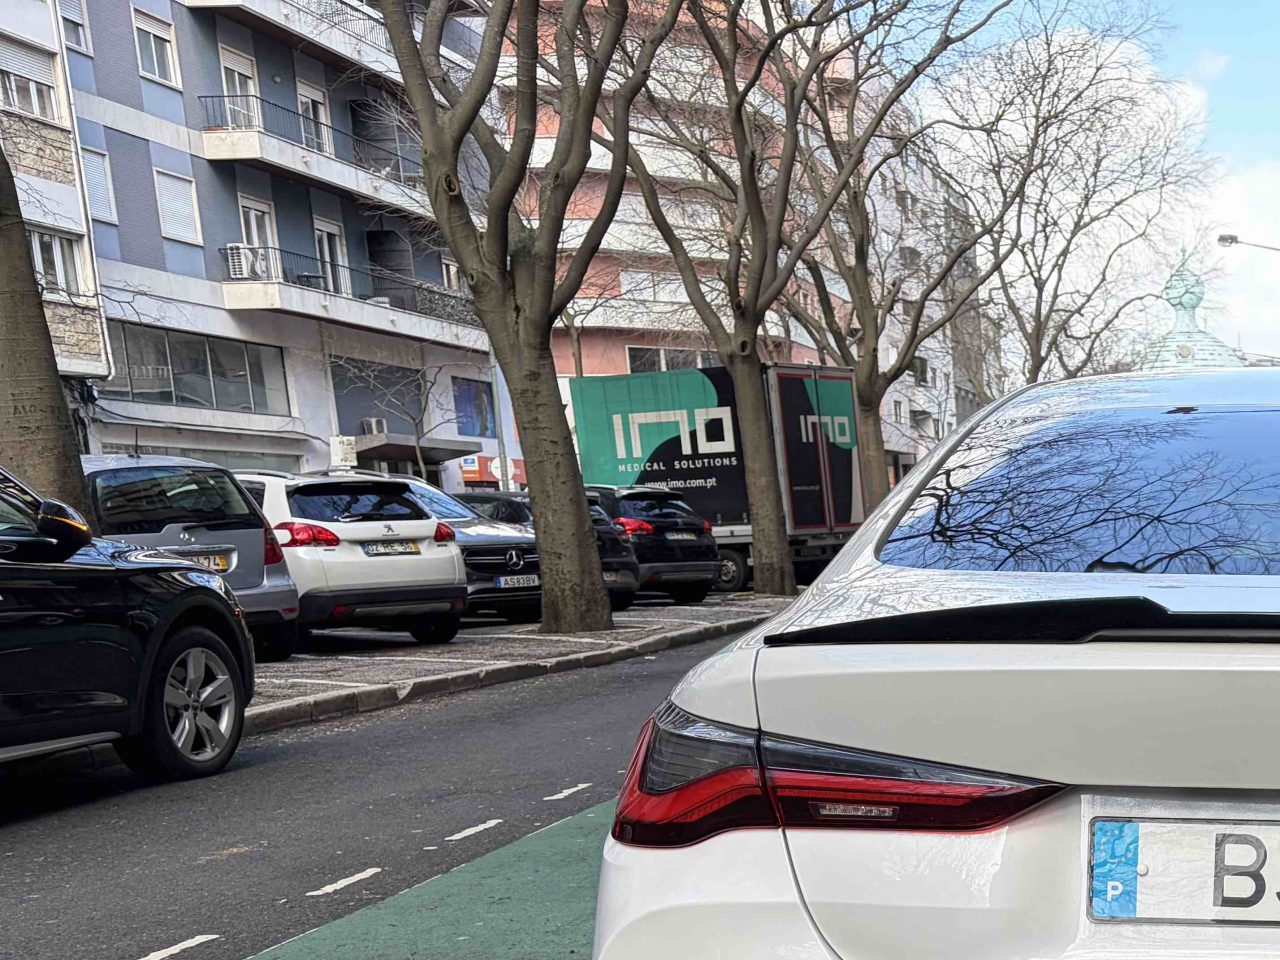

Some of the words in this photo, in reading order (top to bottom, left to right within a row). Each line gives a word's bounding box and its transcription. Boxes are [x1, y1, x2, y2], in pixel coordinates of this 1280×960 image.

[618, 462, 666, 472] MEDICAL
[674, 457, 738, 469] SOLUTIONS
[645, 476, 717, 490] www.imo.com.pt
[1106, 881, 1124, 902] P
